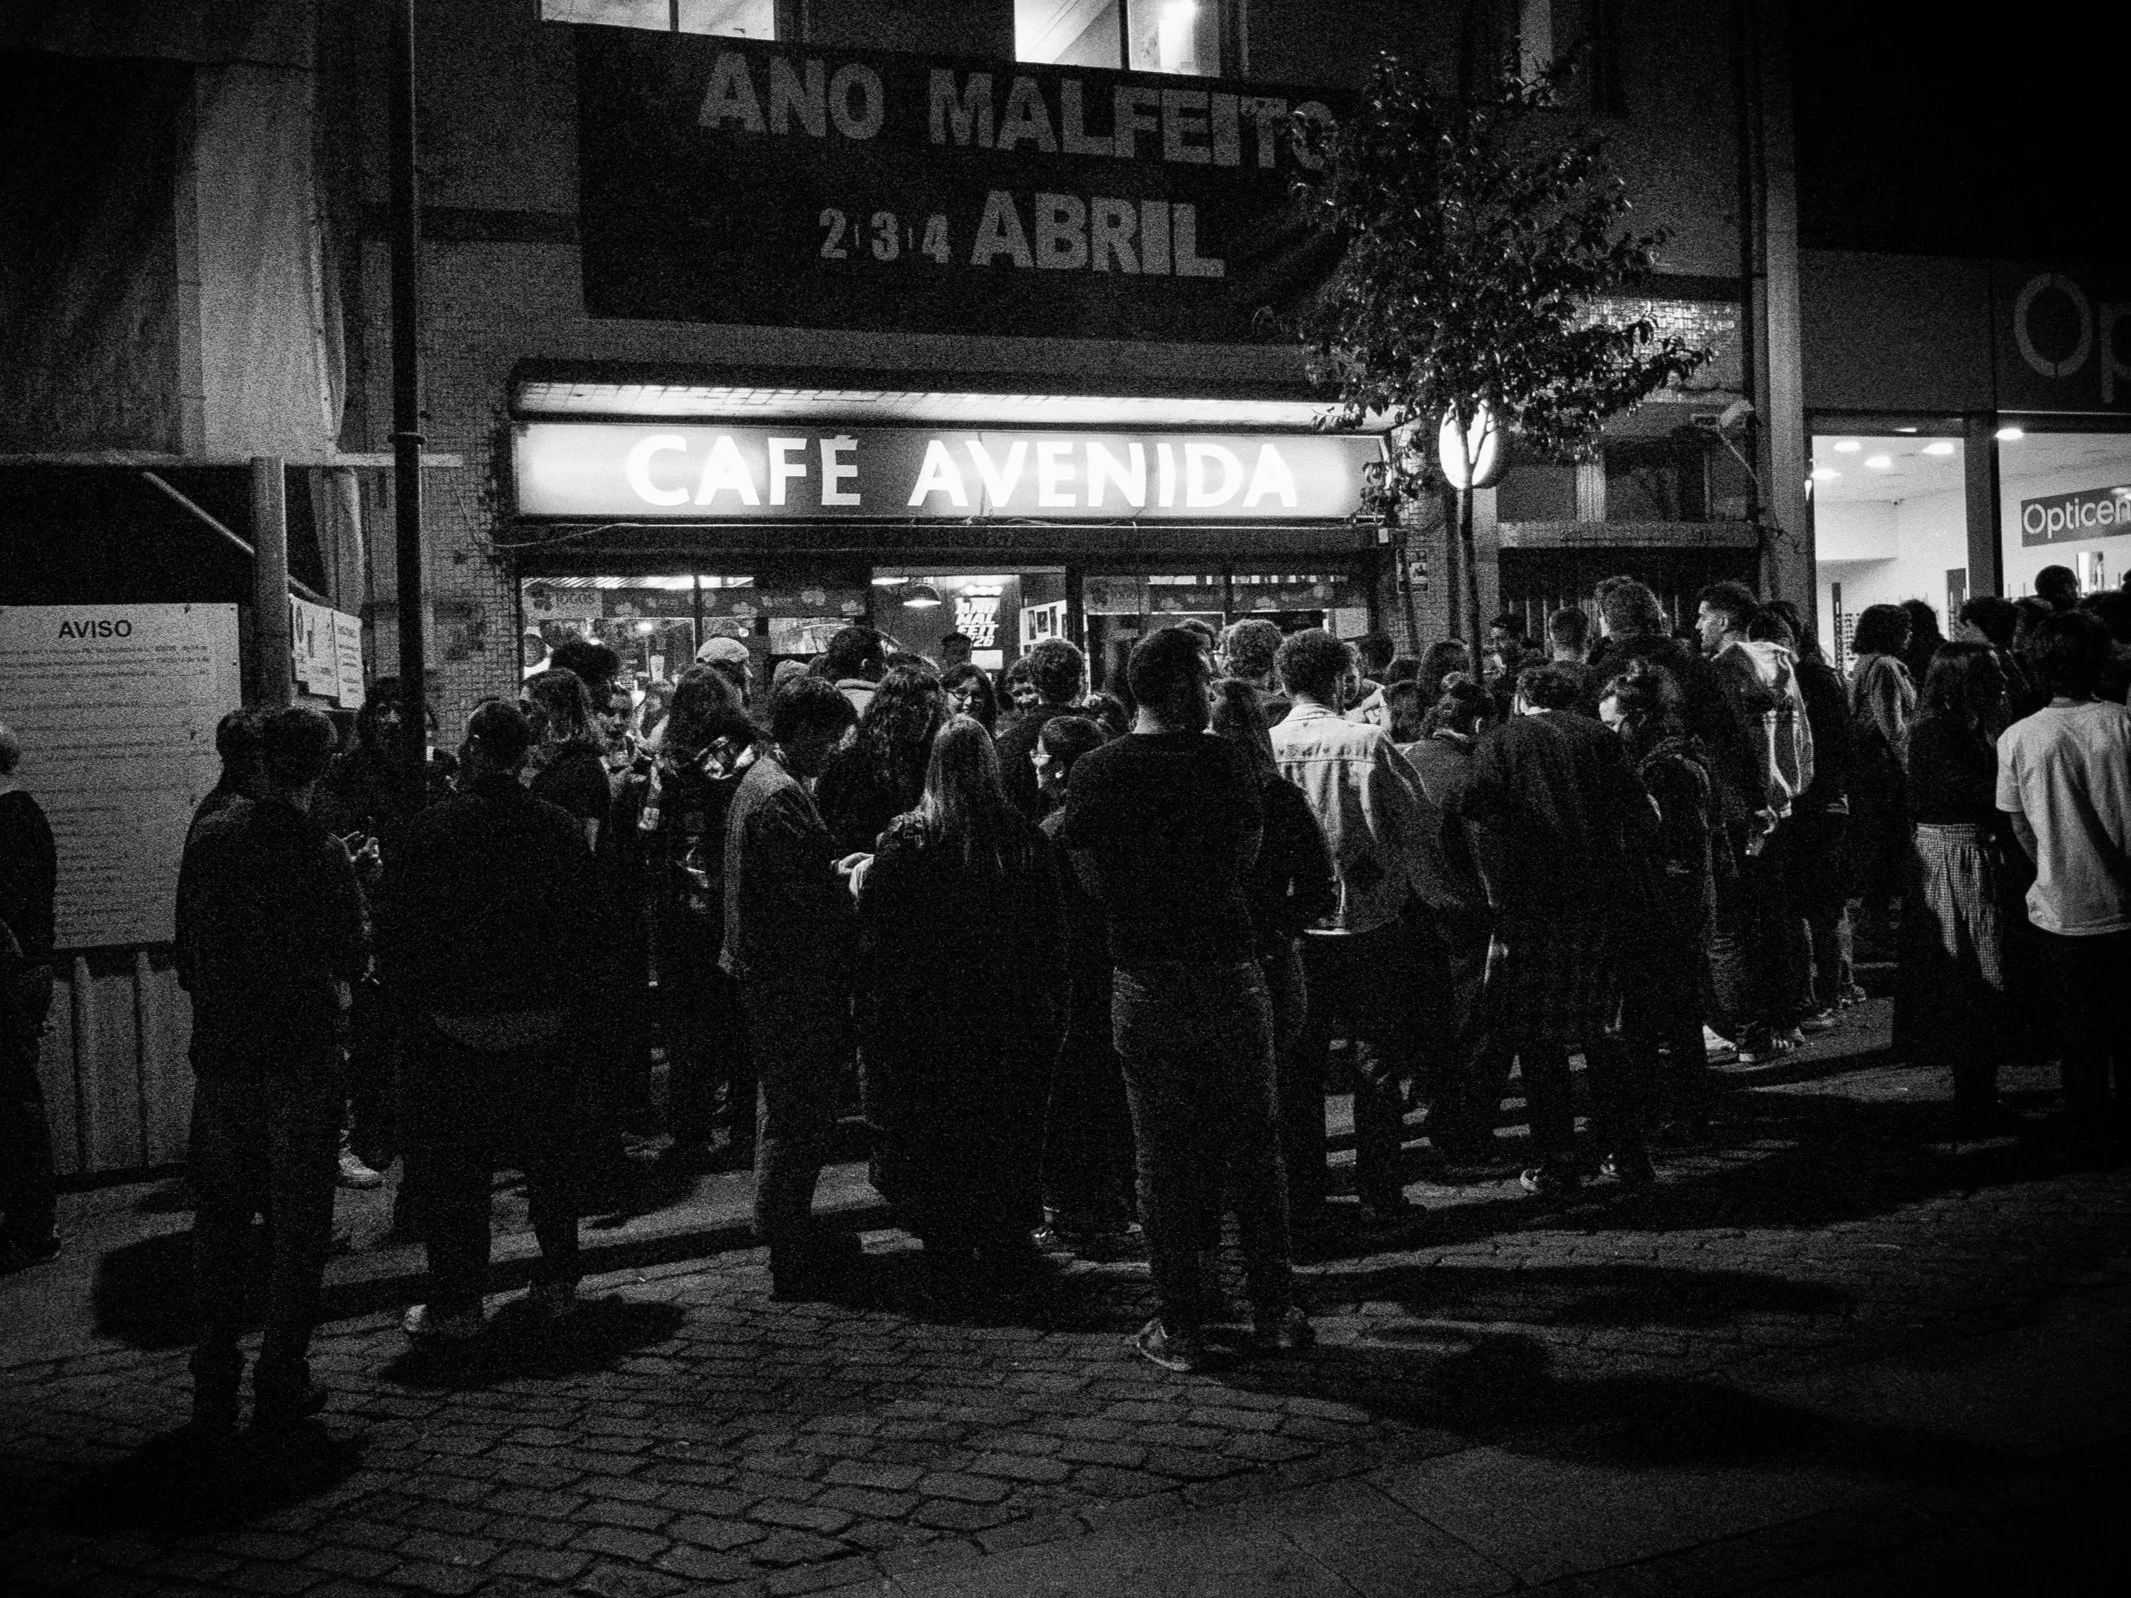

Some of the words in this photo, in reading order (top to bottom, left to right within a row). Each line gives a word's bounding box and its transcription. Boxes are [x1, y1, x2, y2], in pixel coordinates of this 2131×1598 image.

[699, 52, 884, 140] ANO
[929, 69, 1339, 171] MALFEITO
[970, 189, 1225, 277] ABRIL
[626, 434, 861, 506] CAFÉ
[907, 439, 1298, 508] AVENIDA
[58, 620, 132, 638] AVISO
[956, 613, 996, 625] MAL
